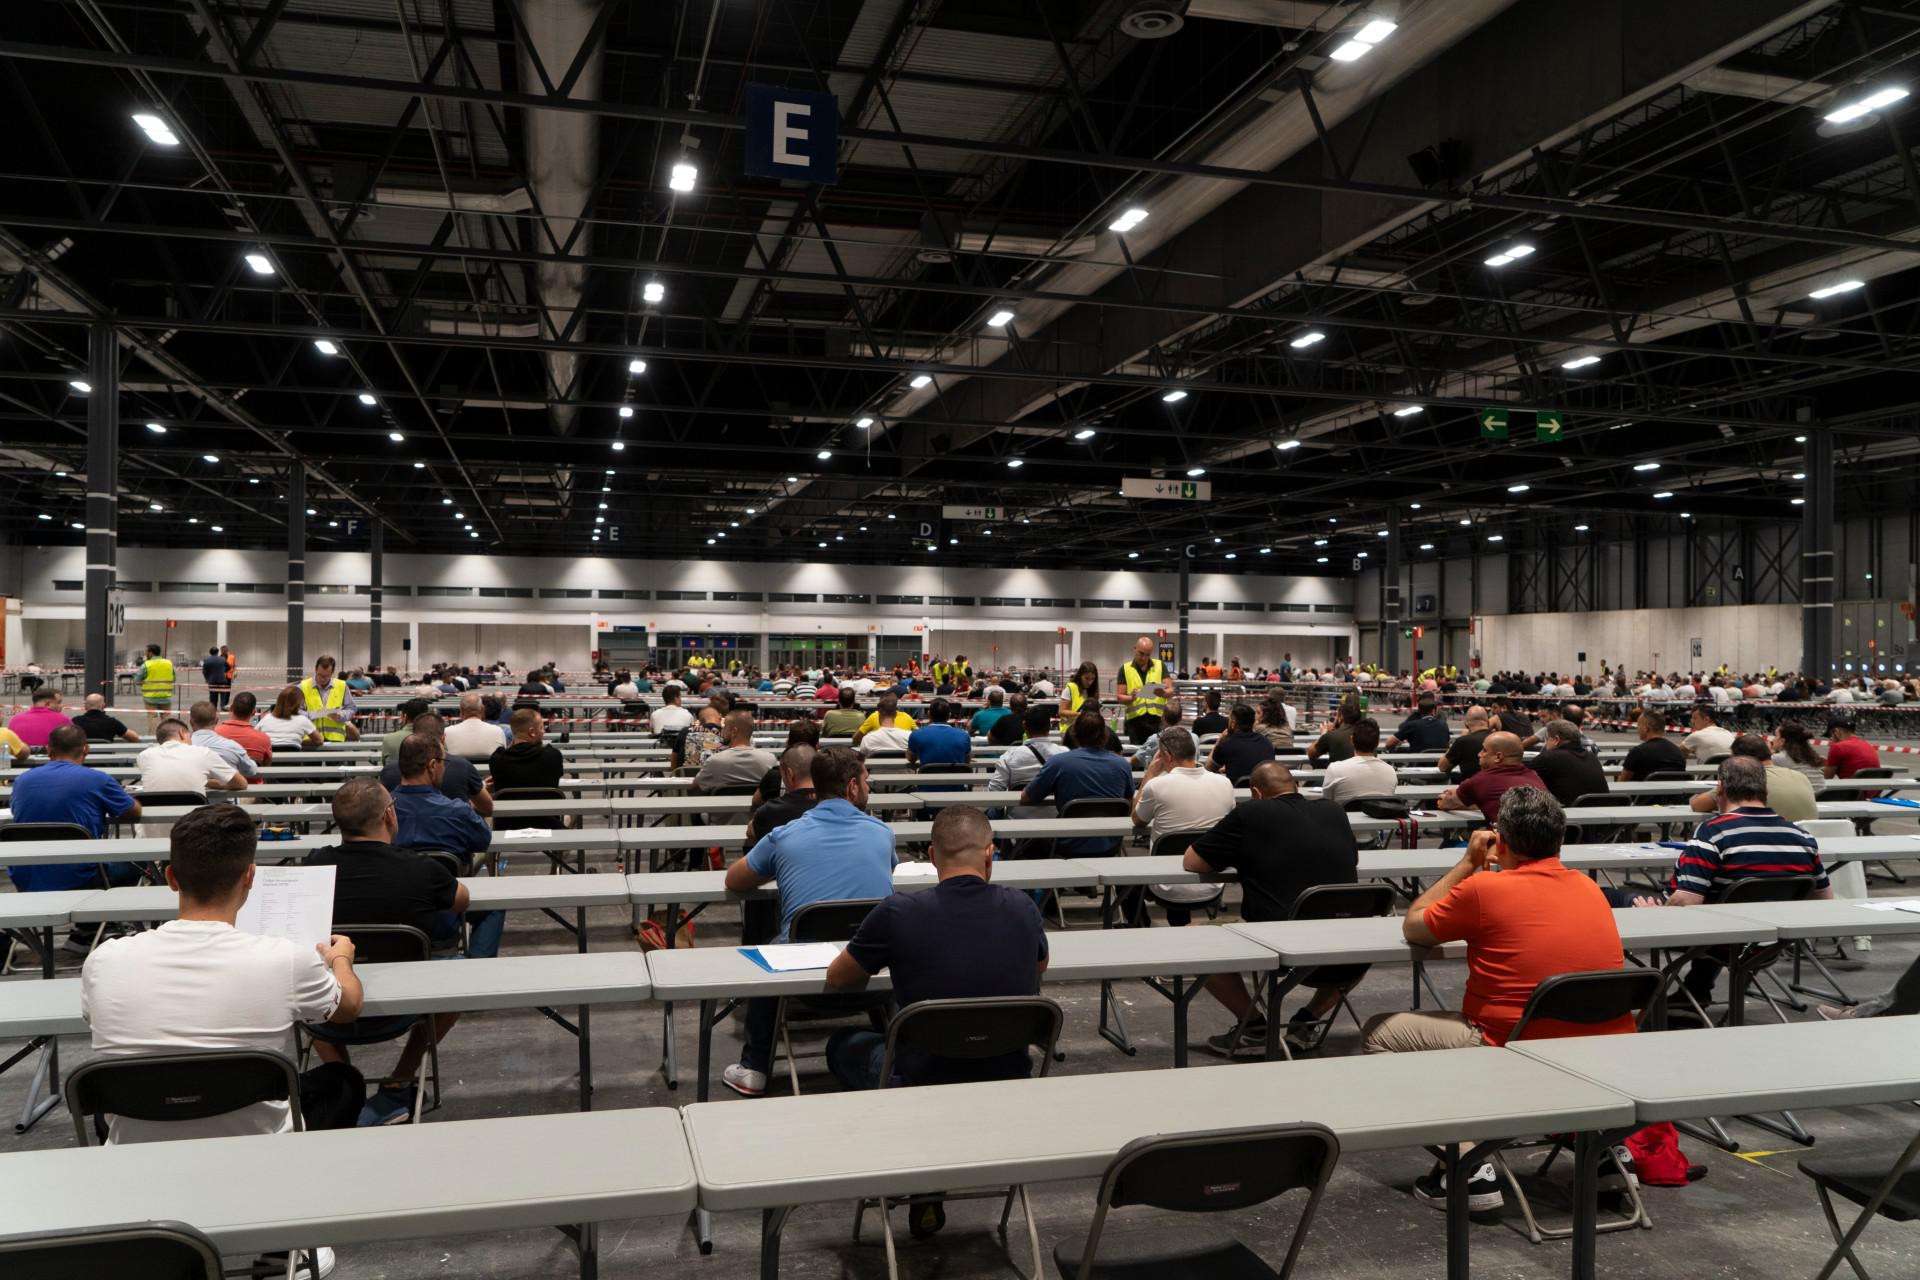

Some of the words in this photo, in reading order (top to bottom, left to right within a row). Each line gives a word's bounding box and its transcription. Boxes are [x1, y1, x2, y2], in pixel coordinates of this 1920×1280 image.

[773, 101, 811, 167] E
[347, 520, 358, 535] F
[609, 526, 619, 541] E
[920, 522, 932, 537] D
[1185, 544, 1196, 558] C
[1352, 558, 1361, 571] B
[1734, 567, 1744, 580] A
[109, 603, 124, 634] D13
